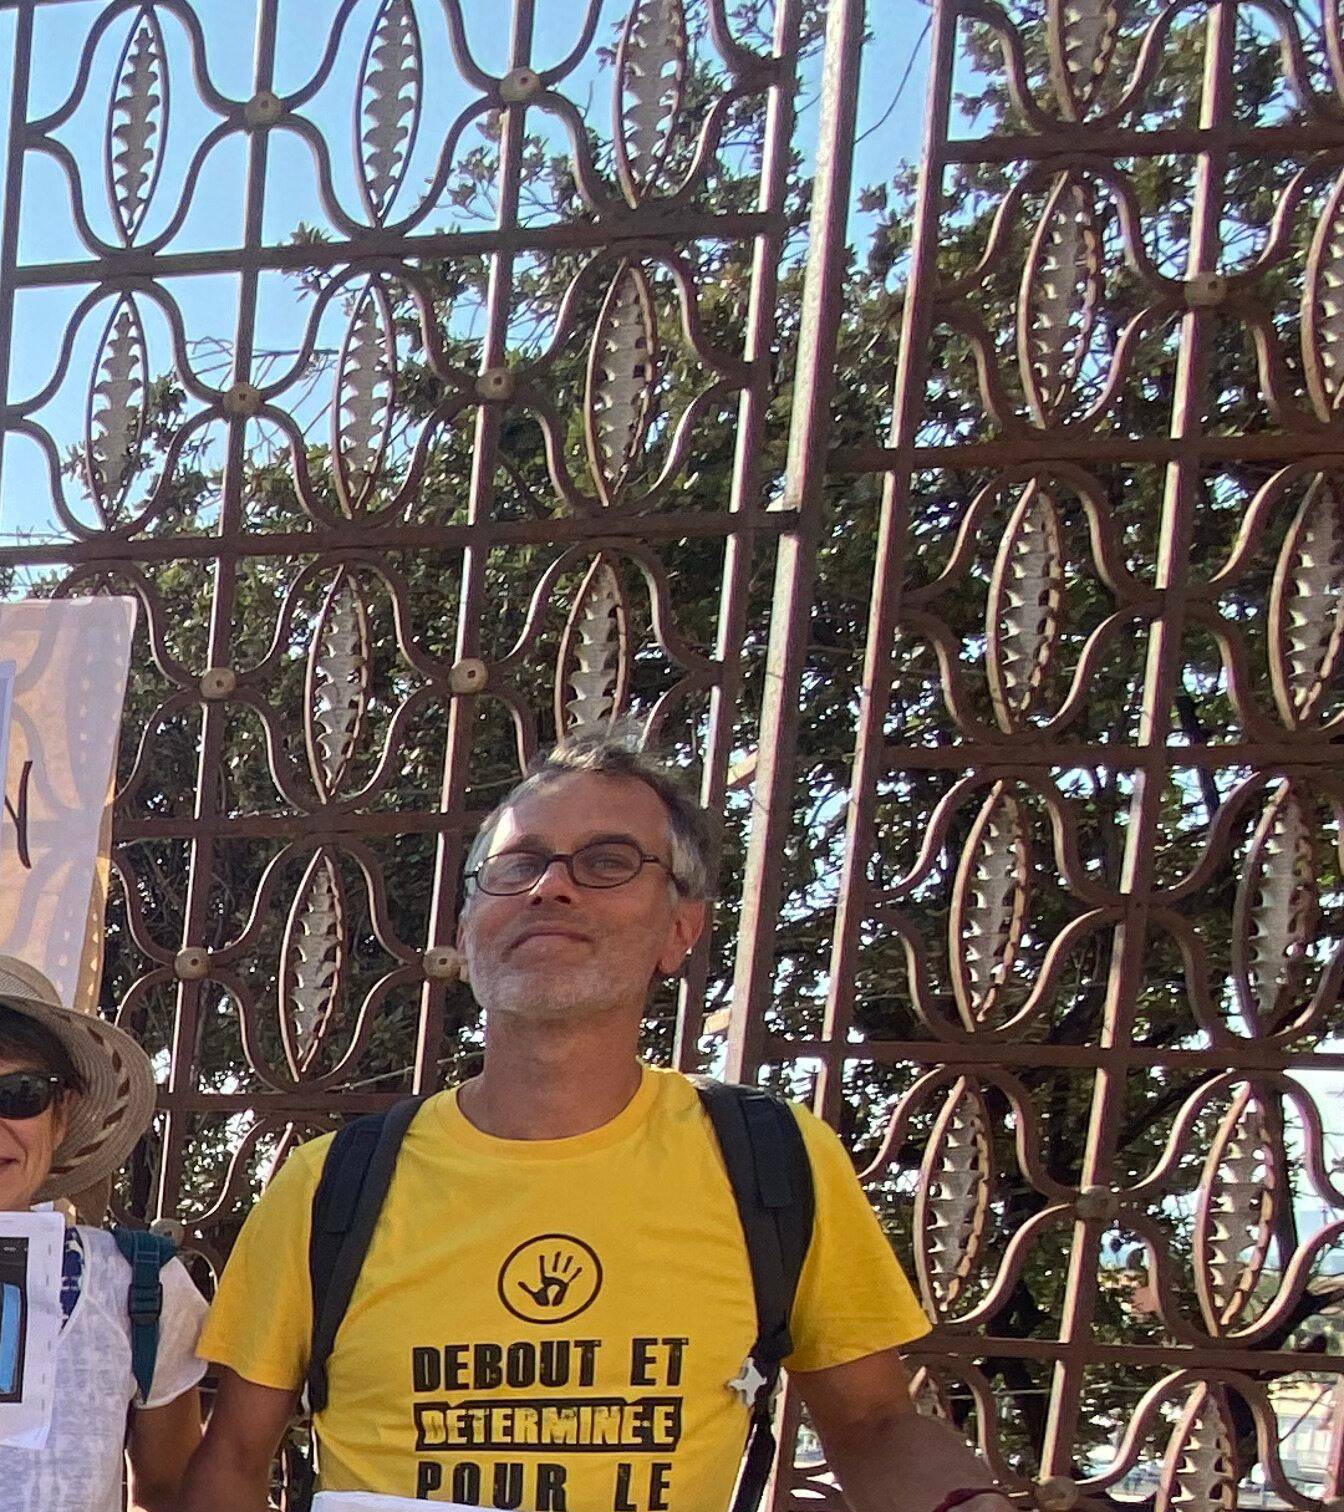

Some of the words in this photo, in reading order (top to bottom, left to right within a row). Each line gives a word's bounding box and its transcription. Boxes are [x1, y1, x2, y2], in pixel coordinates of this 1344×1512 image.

[412, 1339, 602, 1393] DEBOUT
[629, 1337, 690, 1387] ET
[416, 1460, 568, 1512] POUR
[613, 1461, 673, 1512] LE
